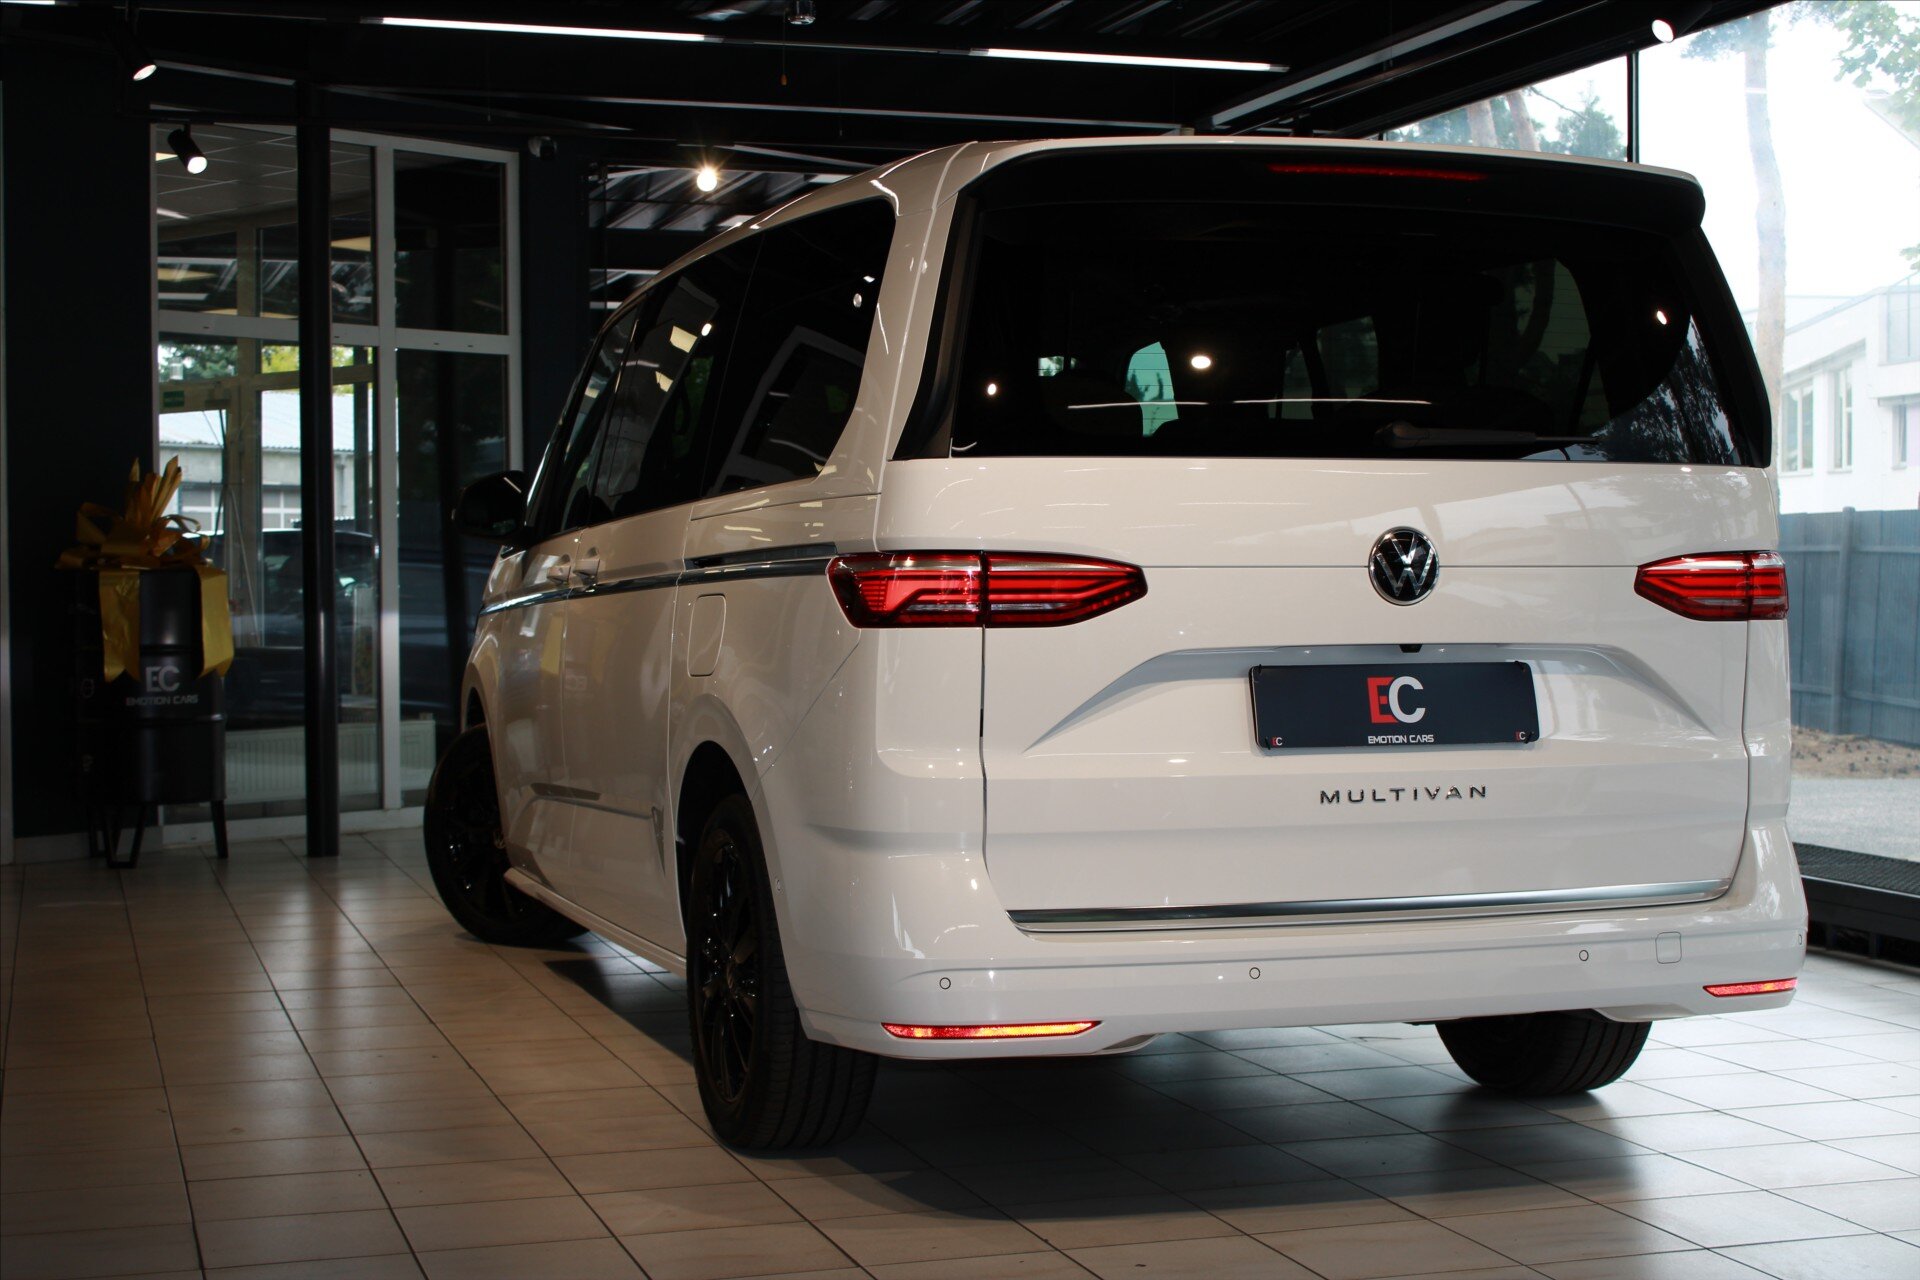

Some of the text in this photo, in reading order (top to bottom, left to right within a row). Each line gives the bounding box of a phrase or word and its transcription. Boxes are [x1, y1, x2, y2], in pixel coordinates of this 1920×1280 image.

[145, 665, 180, 692] EC
[126, 694, 199, 706] EMOTION CARS
[1367, 676, 1426, 723] EC
[1367, 734, 1435, 744] EMOTION CARS
[1320, 785, 1487, 804] MULTIVAN
